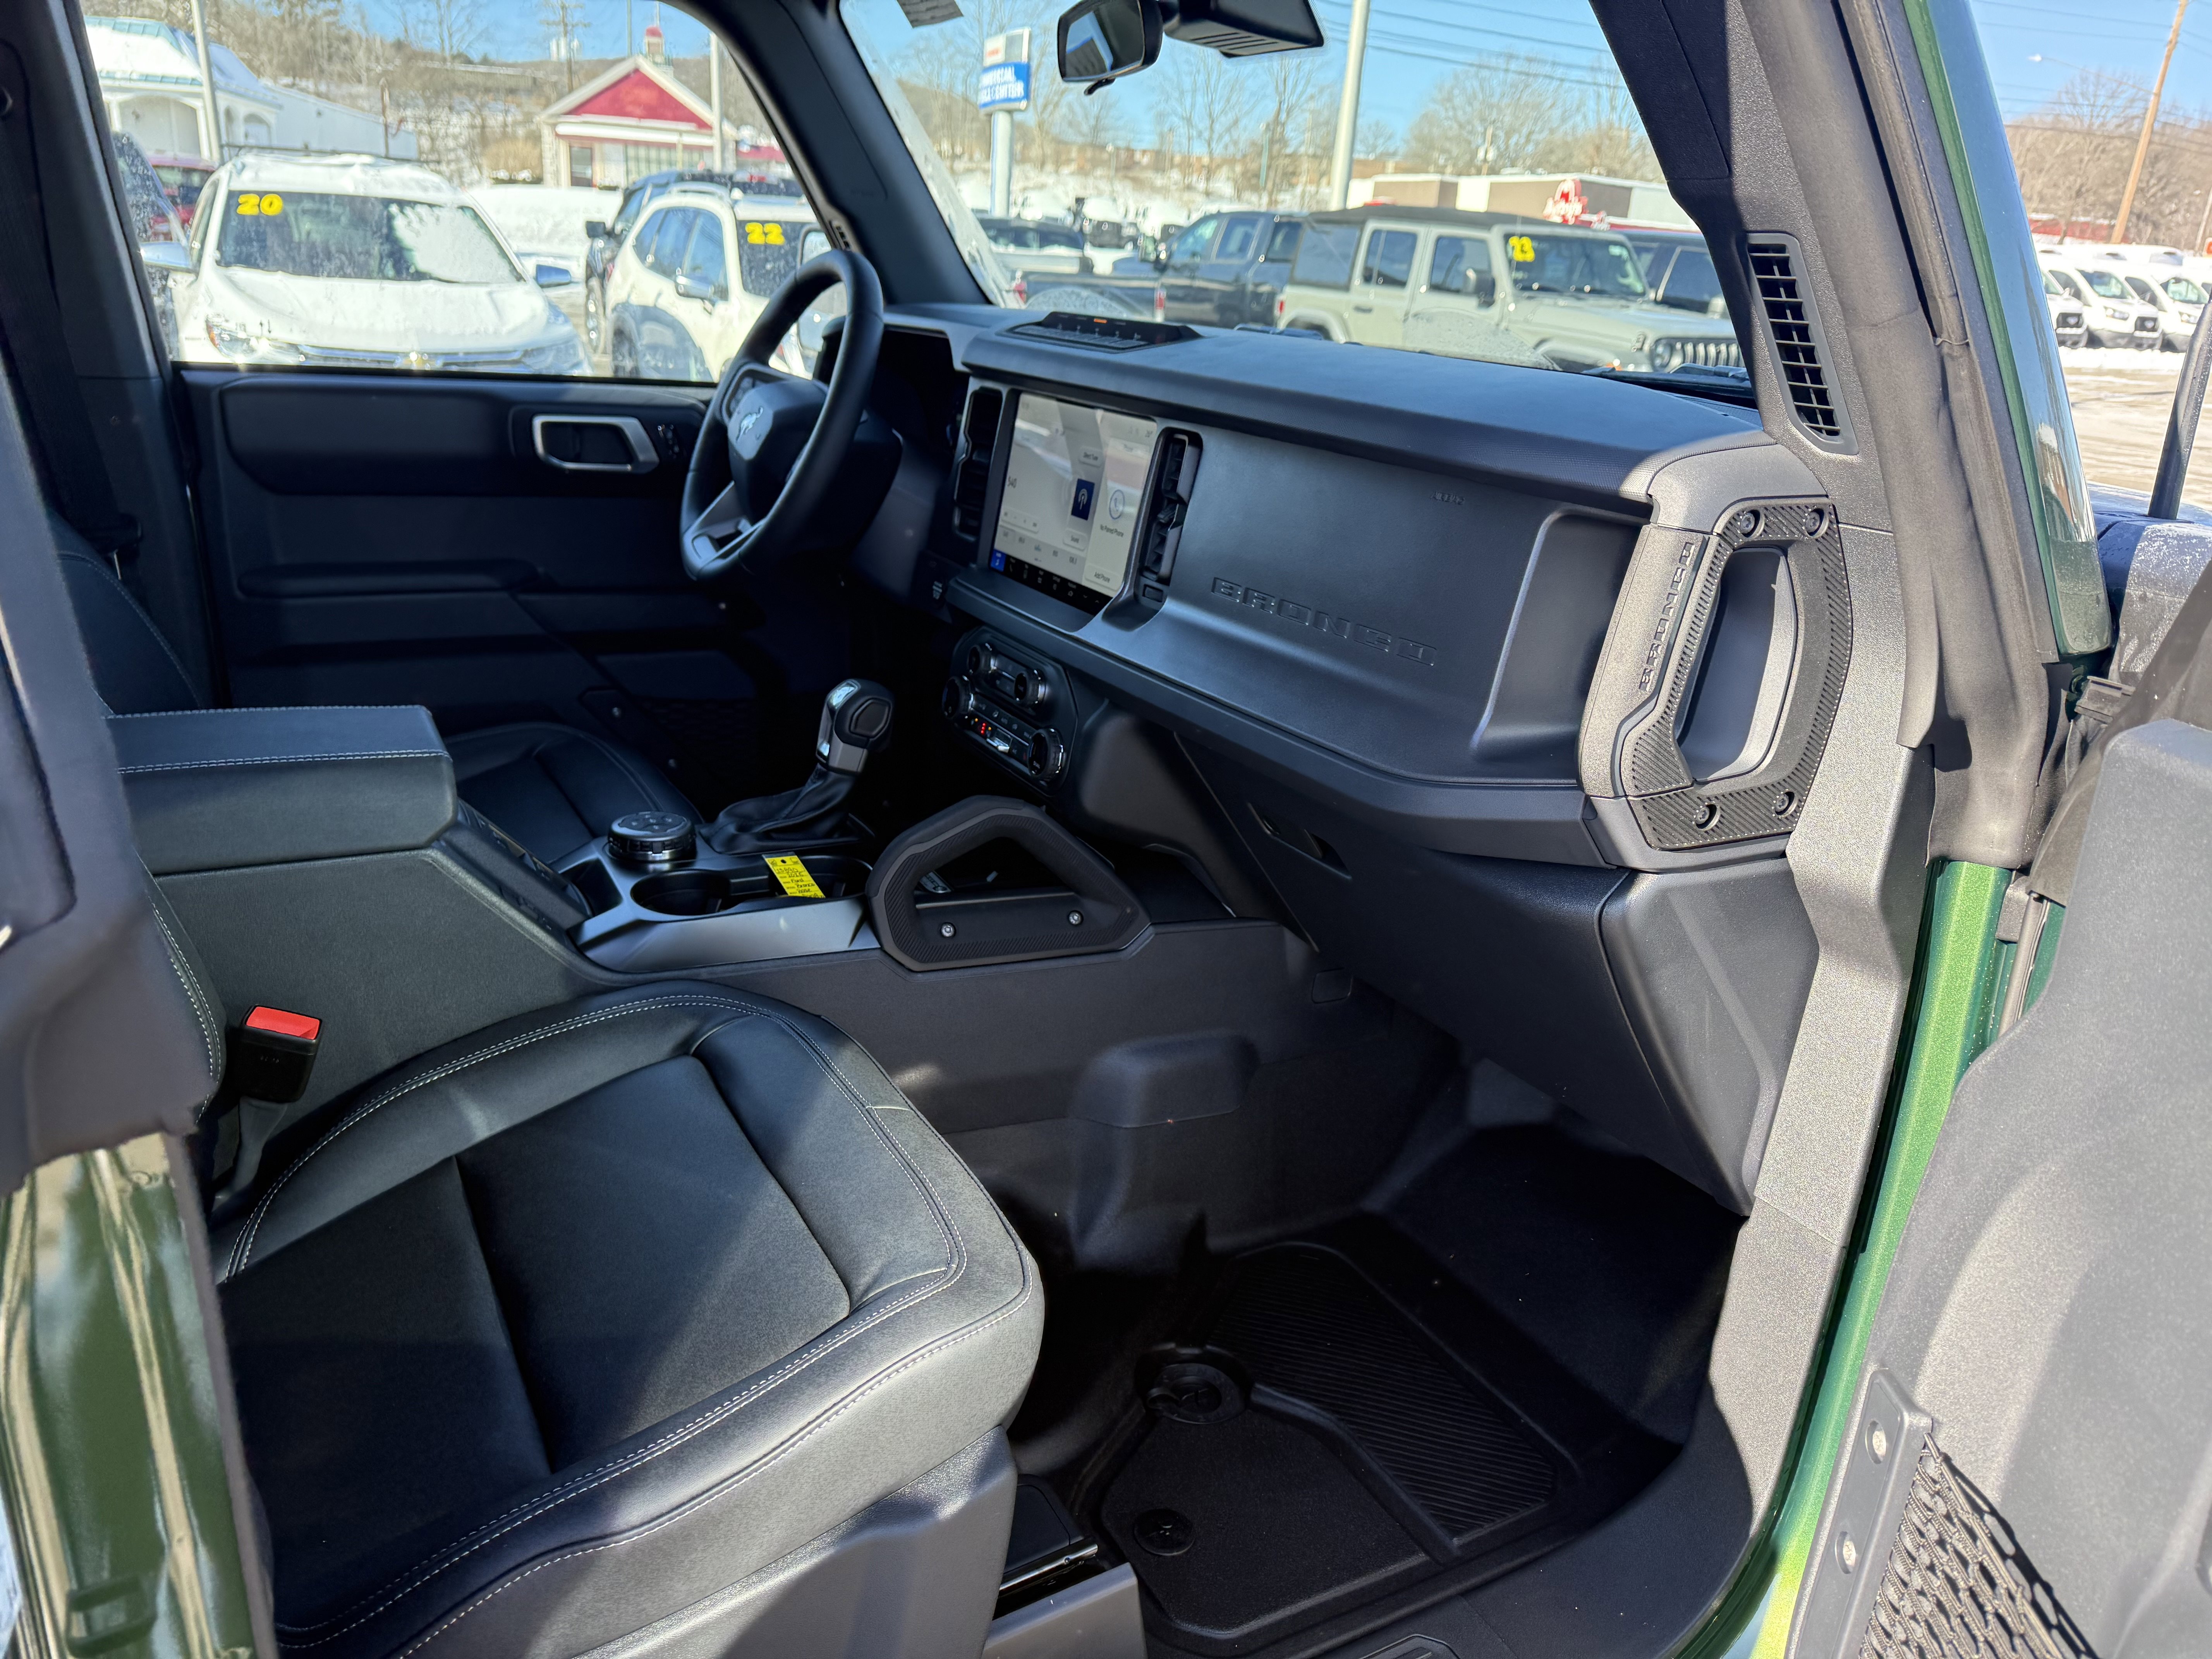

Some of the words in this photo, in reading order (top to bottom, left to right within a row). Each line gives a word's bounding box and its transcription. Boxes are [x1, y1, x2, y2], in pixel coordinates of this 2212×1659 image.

[237, 193, 283, 216] 20
[1211, 577, 1437, 666] BRONCO
[1638, 542, 1695, 692] BRONCO
